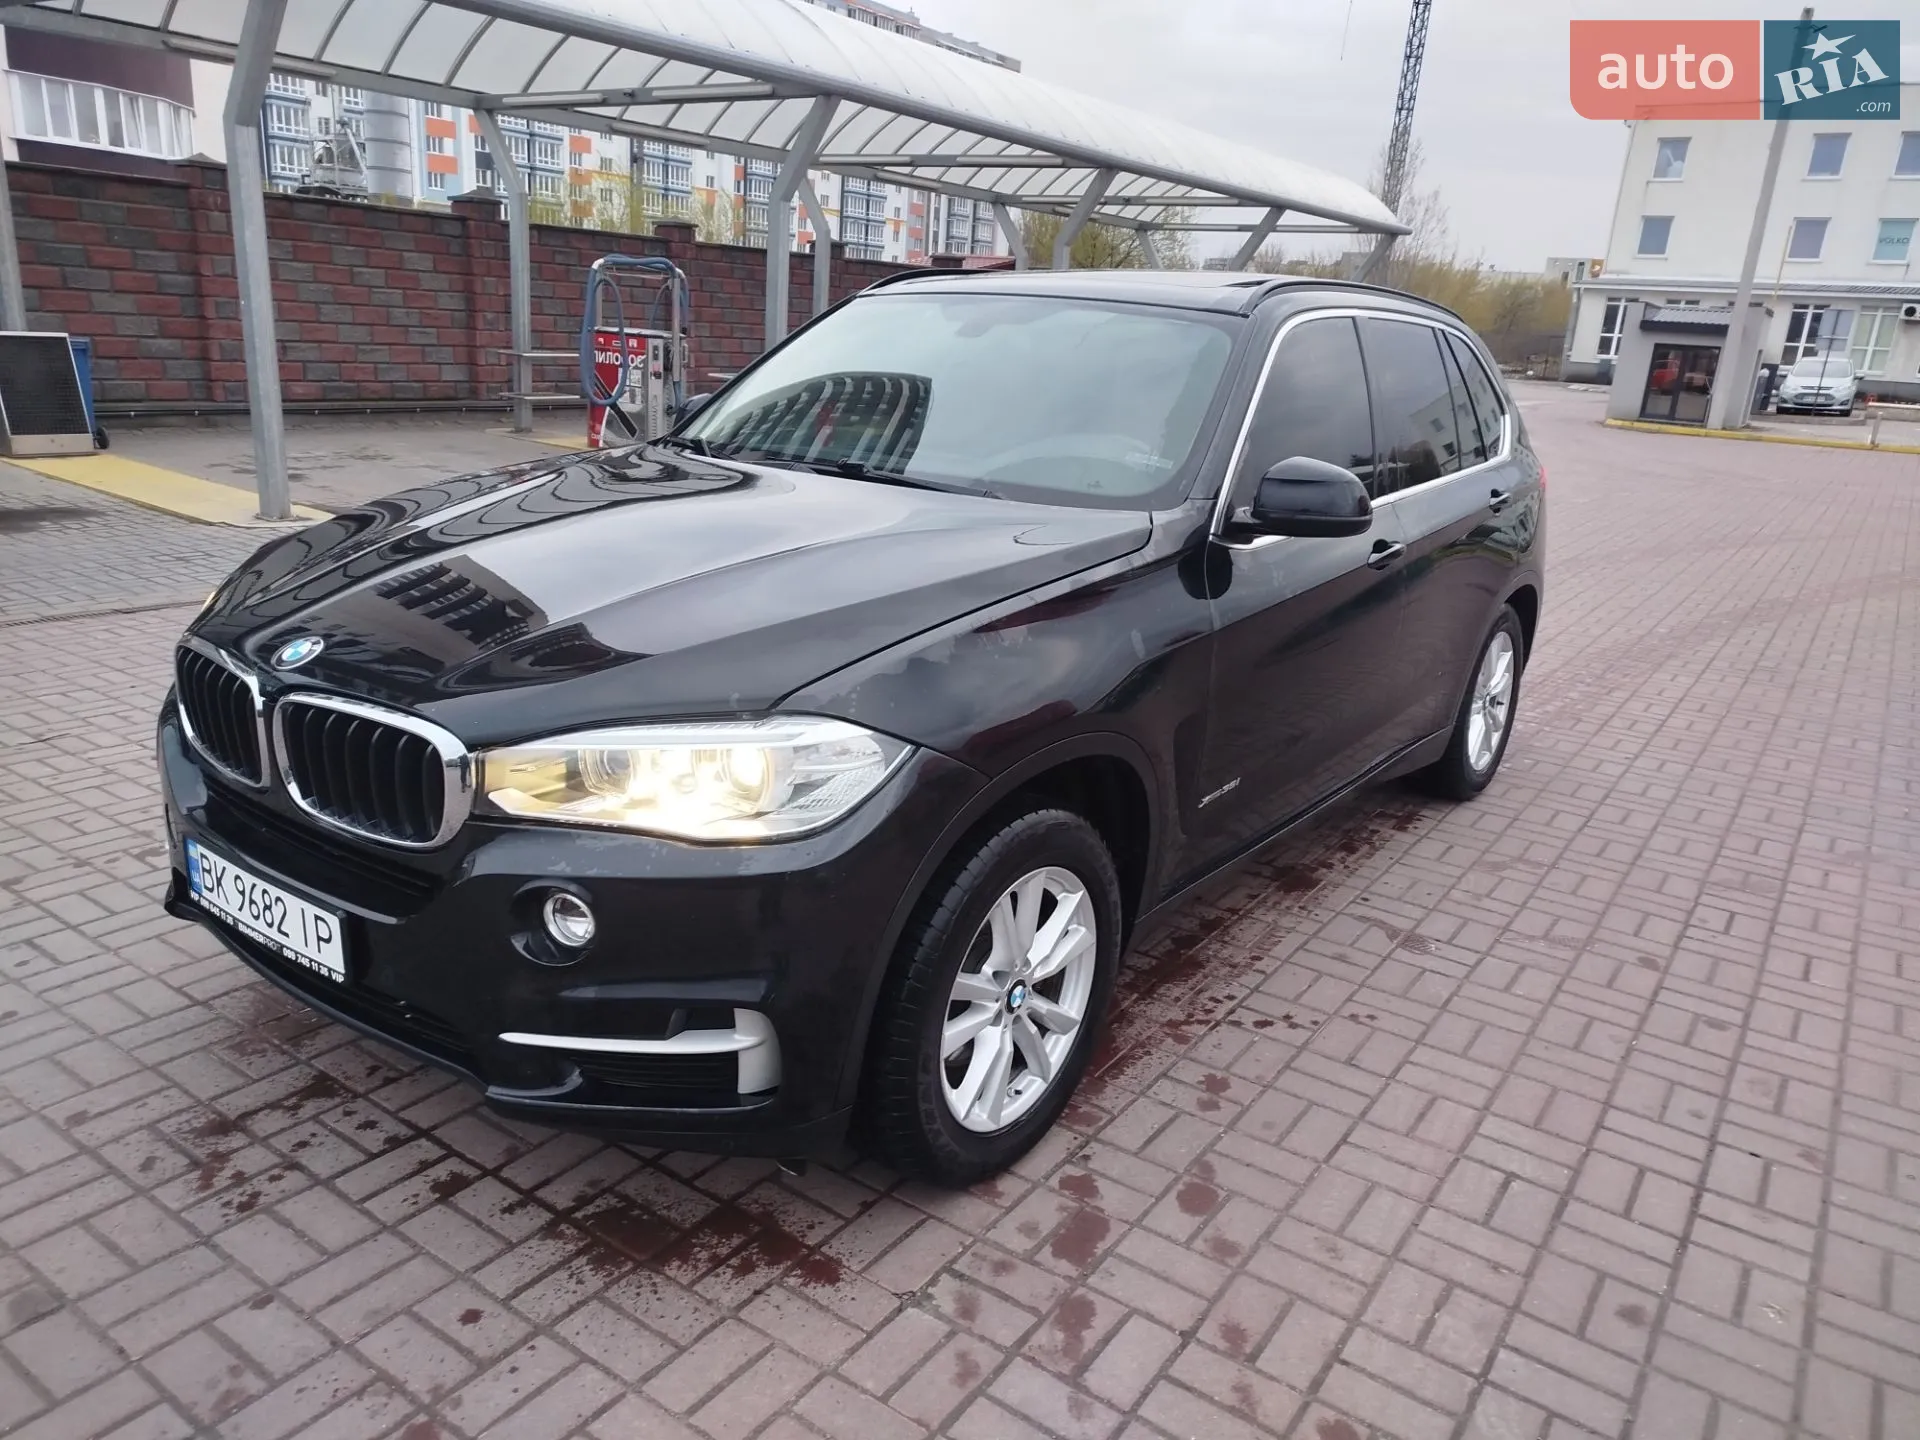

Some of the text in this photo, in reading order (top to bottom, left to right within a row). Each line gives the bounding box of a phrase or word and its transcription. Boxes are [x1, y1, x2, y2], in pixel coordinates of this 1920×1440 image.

[594, 350, 647, 368] ПИЛООС
[200, 851, 333, 954] BK 9682 IP
[330, 970, 345, 983] VIP
